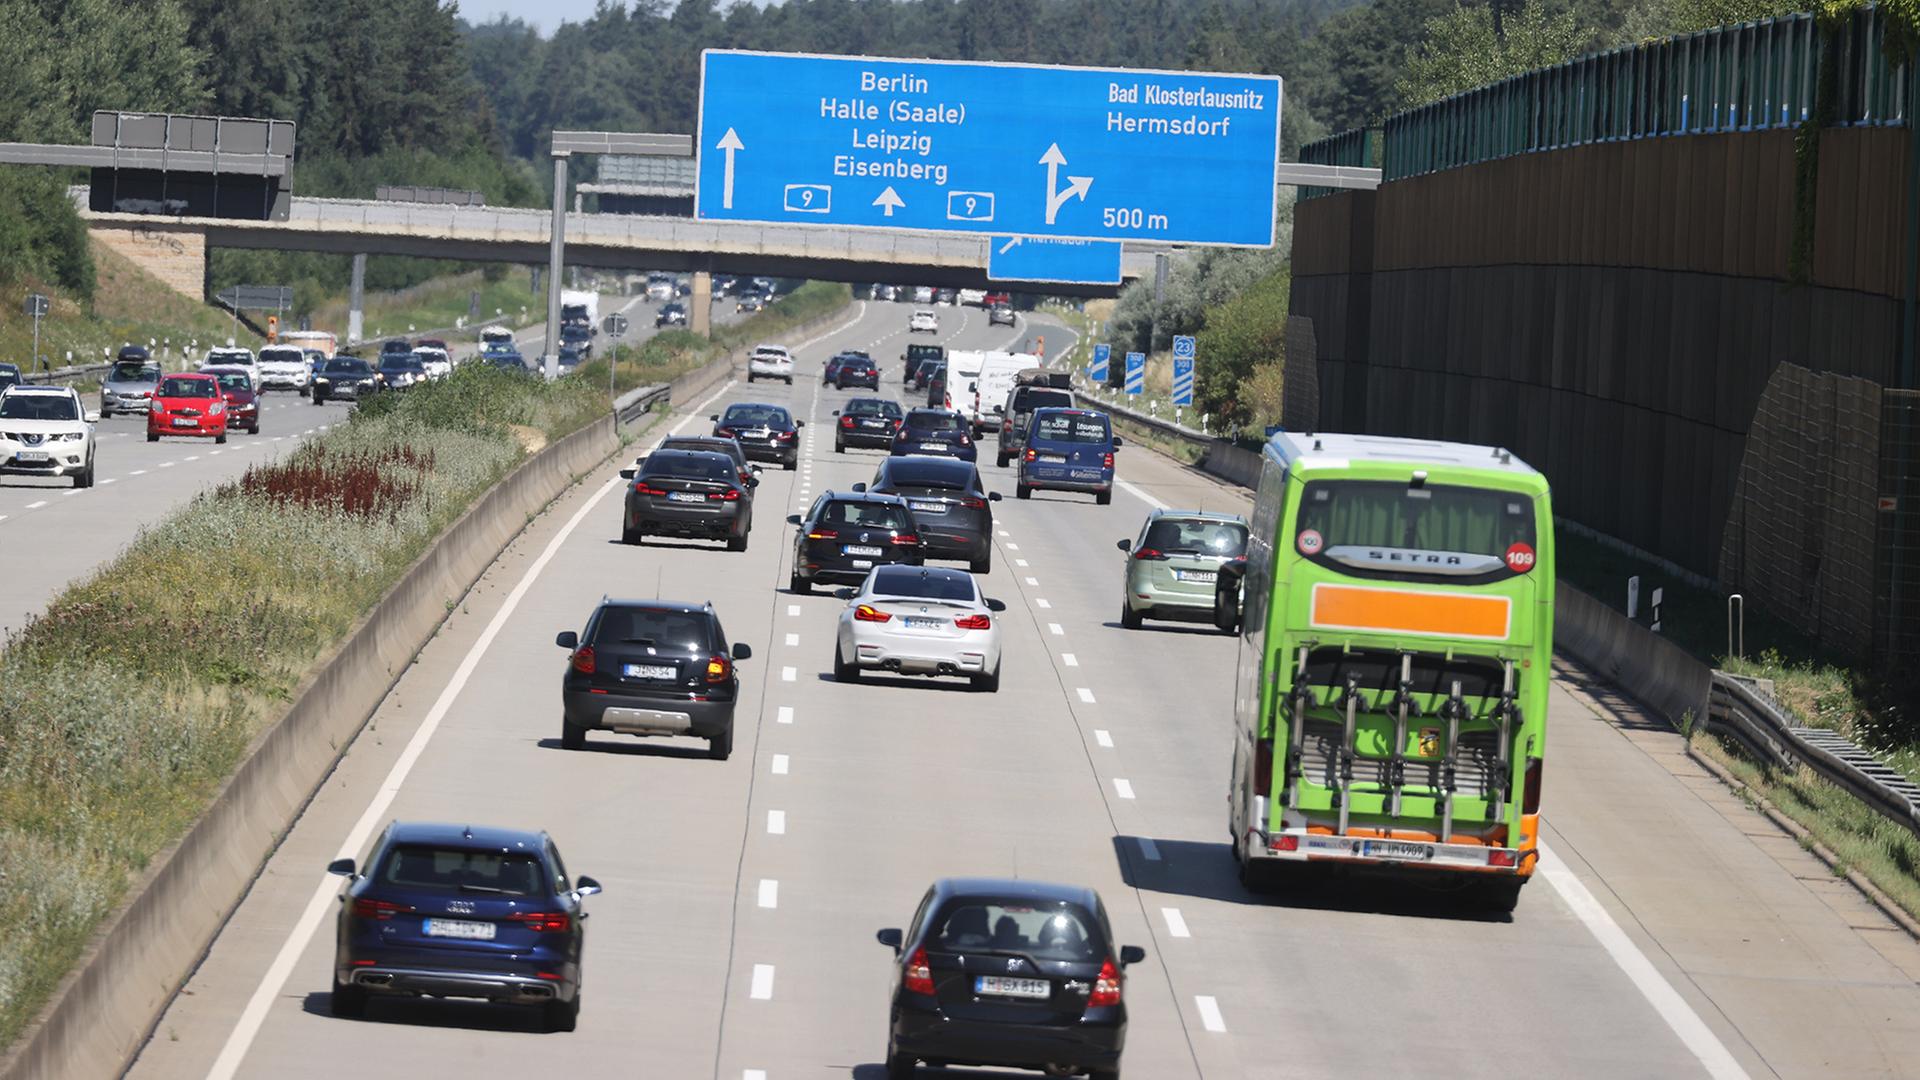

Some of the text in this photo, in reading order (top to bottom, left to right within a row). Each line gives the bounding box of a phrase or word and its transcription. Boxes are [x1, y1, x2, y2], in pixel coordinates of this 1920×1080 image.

[860, 71, 928, 94] Berlin
[1108, 82, 1264, 110] Bad Klosterlausnitz
[820, 97, 966, 126] Halle (Saale)
[1107, 111, 1231, 137] Hermsdorf
[852, 127, 932, 156] Leipzig
[834, 155, 948, 186] Eisenberg
[801, 190, 813, 208] 9
[965, 197, 977, 215] 9
[1103, 207, 1168, 230] 500 m
[1177, 341, 1191, 353] 23
[1368, 551, 1462, 565] SETRA
[1506, 551, 1534, 565] 109
